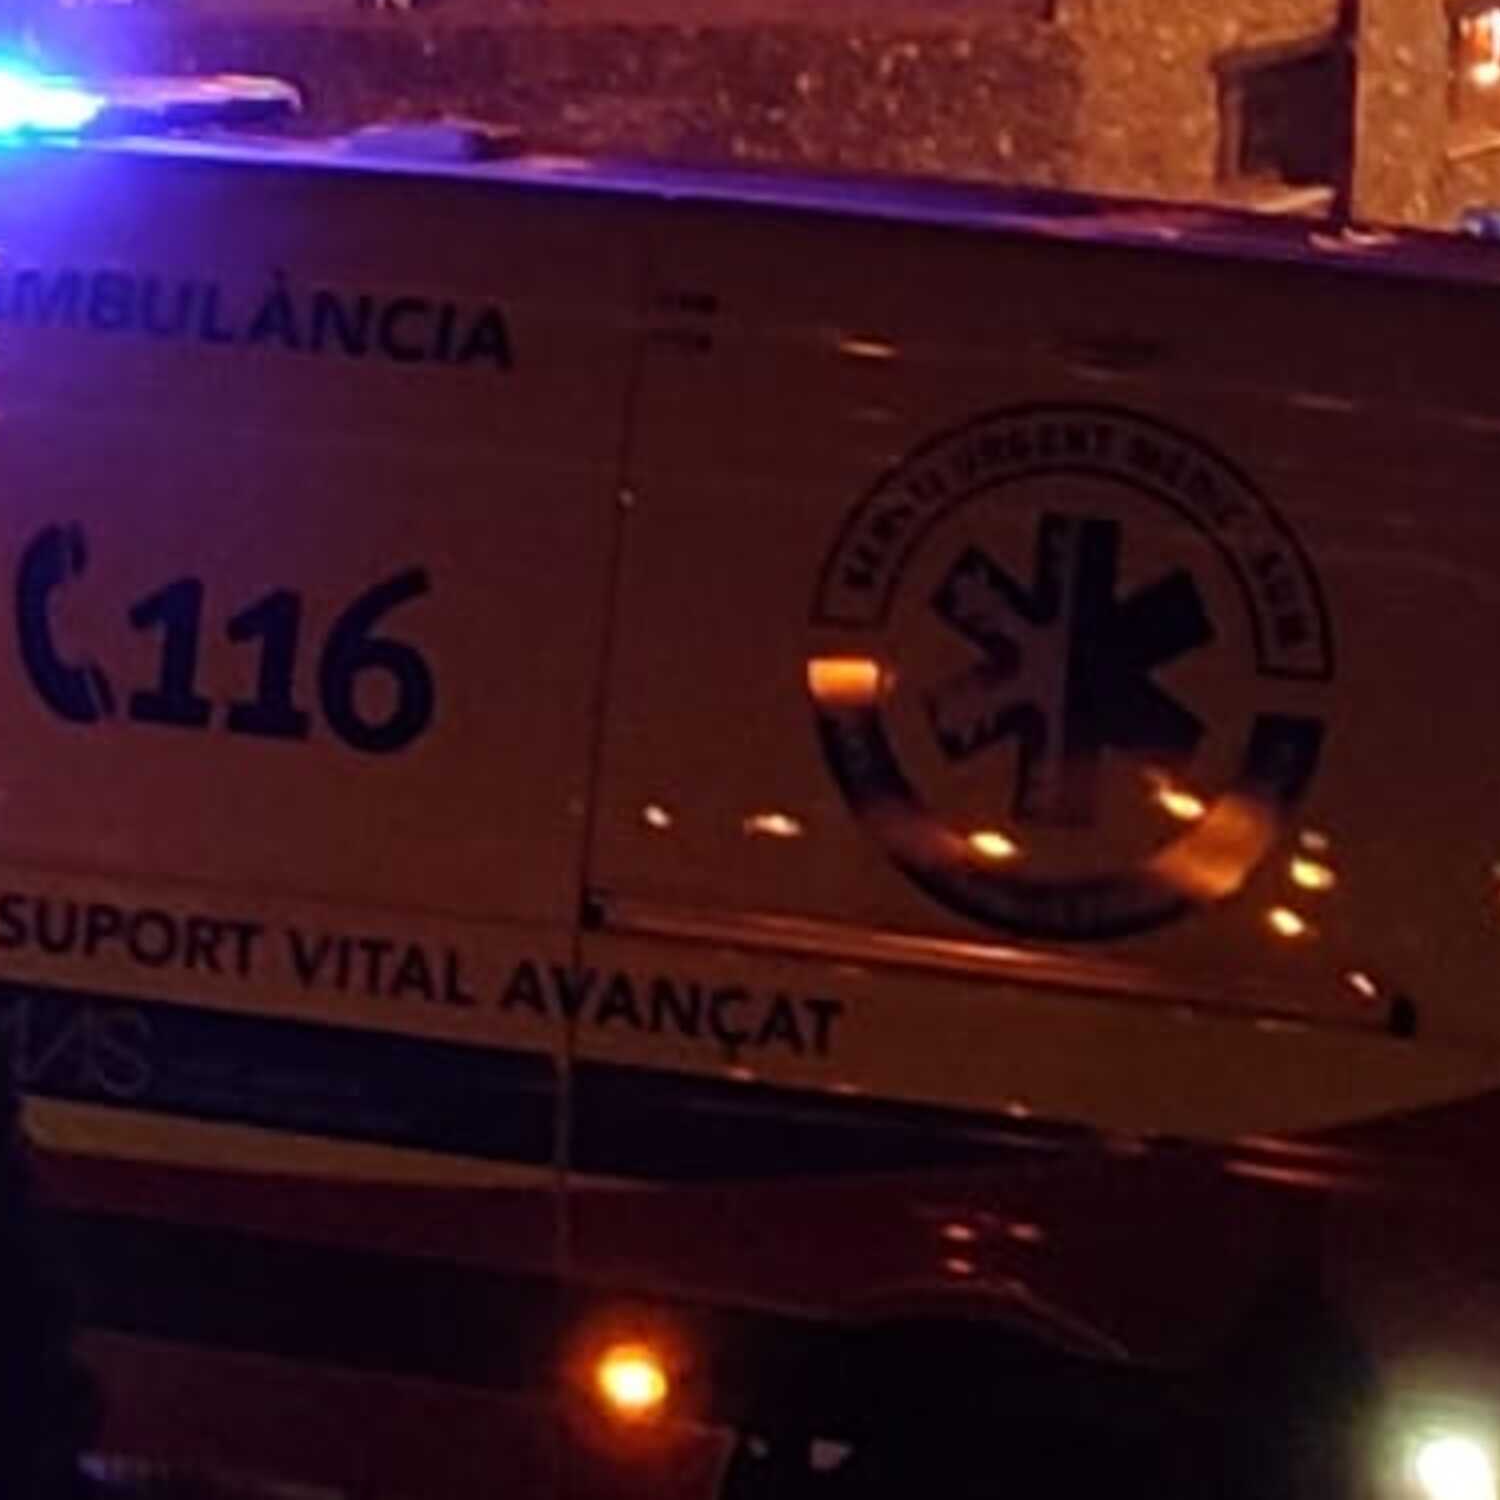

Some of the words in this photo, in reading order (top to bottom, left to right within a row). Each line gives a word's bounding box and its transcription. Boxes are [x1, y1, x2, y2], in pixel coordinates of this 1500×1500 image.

[128, 567, 435, 755] 116
[286, 926, 474, 1005] VITAL
[502, 958, 845, 1060] AVANÇAT
